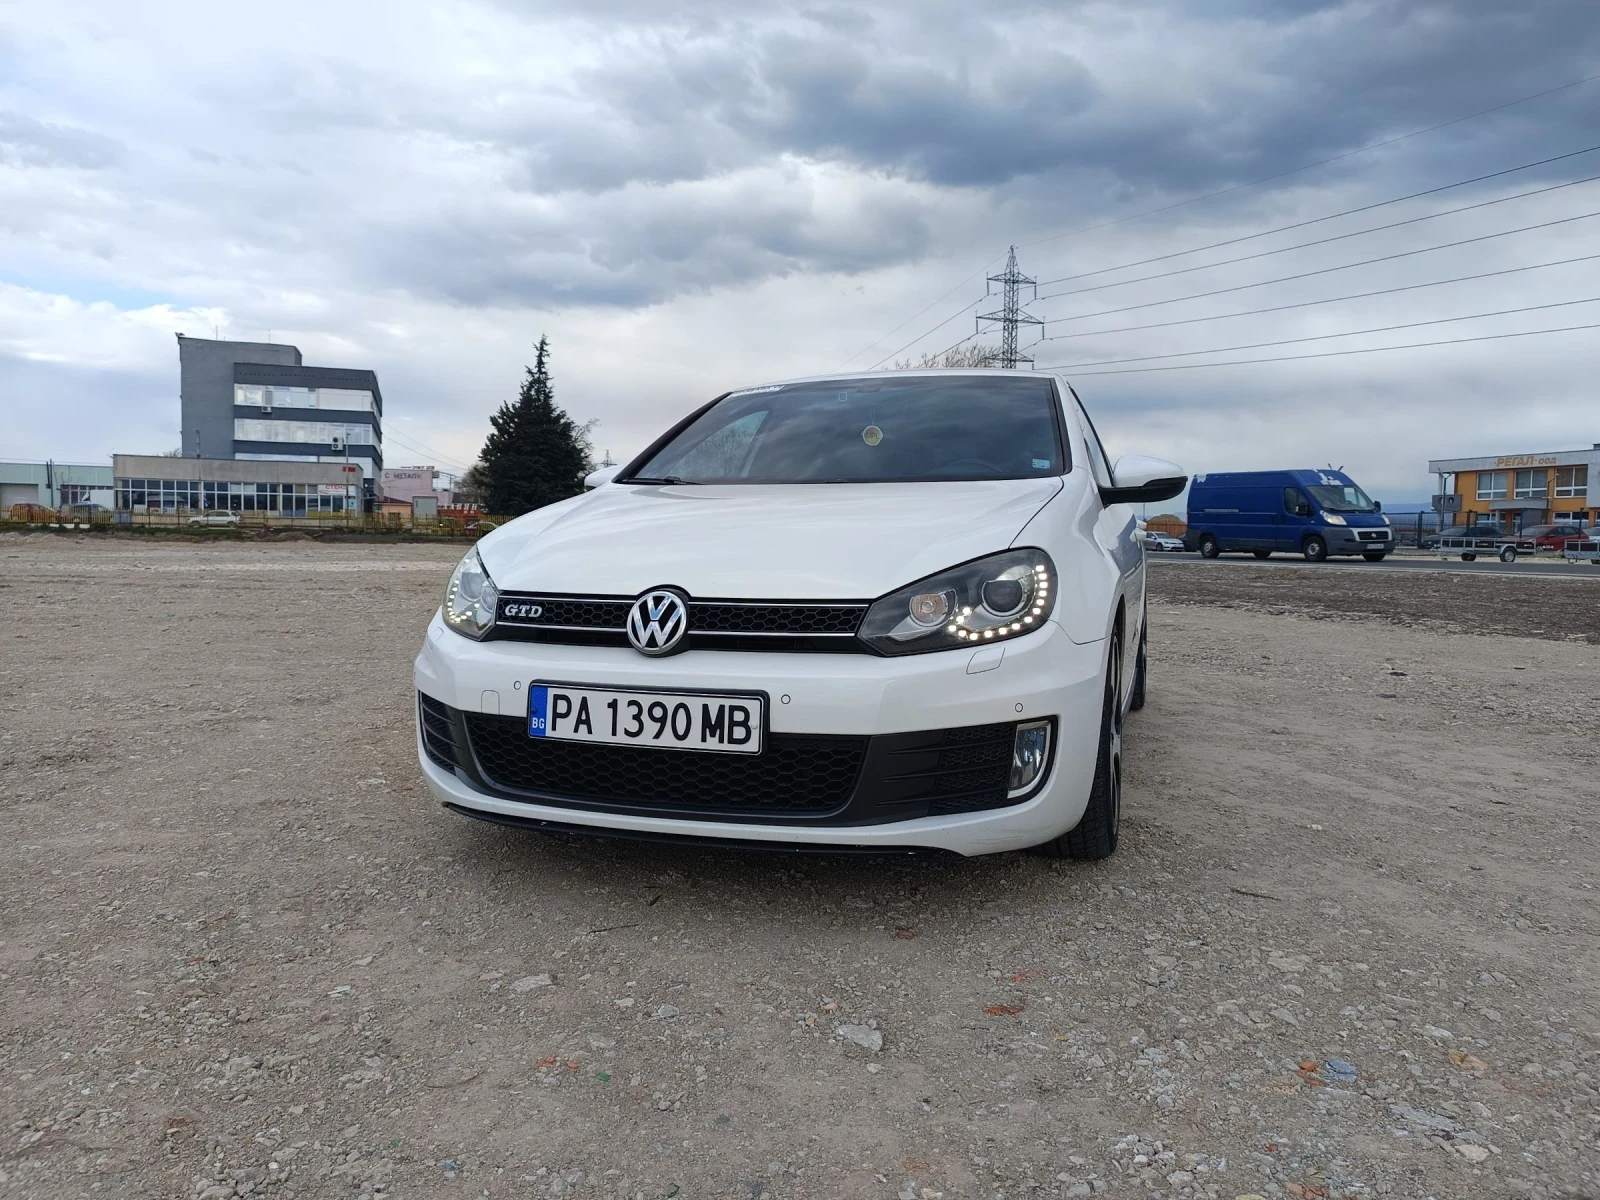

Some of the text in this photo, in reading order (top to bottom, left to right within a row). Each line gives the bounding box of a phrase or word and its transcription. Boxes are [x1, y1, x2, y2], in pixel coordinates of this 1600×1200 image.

[504, 603, 543, 618] GTD
[630, 592, 684, 651] VW
[531, 717, 545, 729] BG
[550, 693, 752, 745] PA 1390 MB
